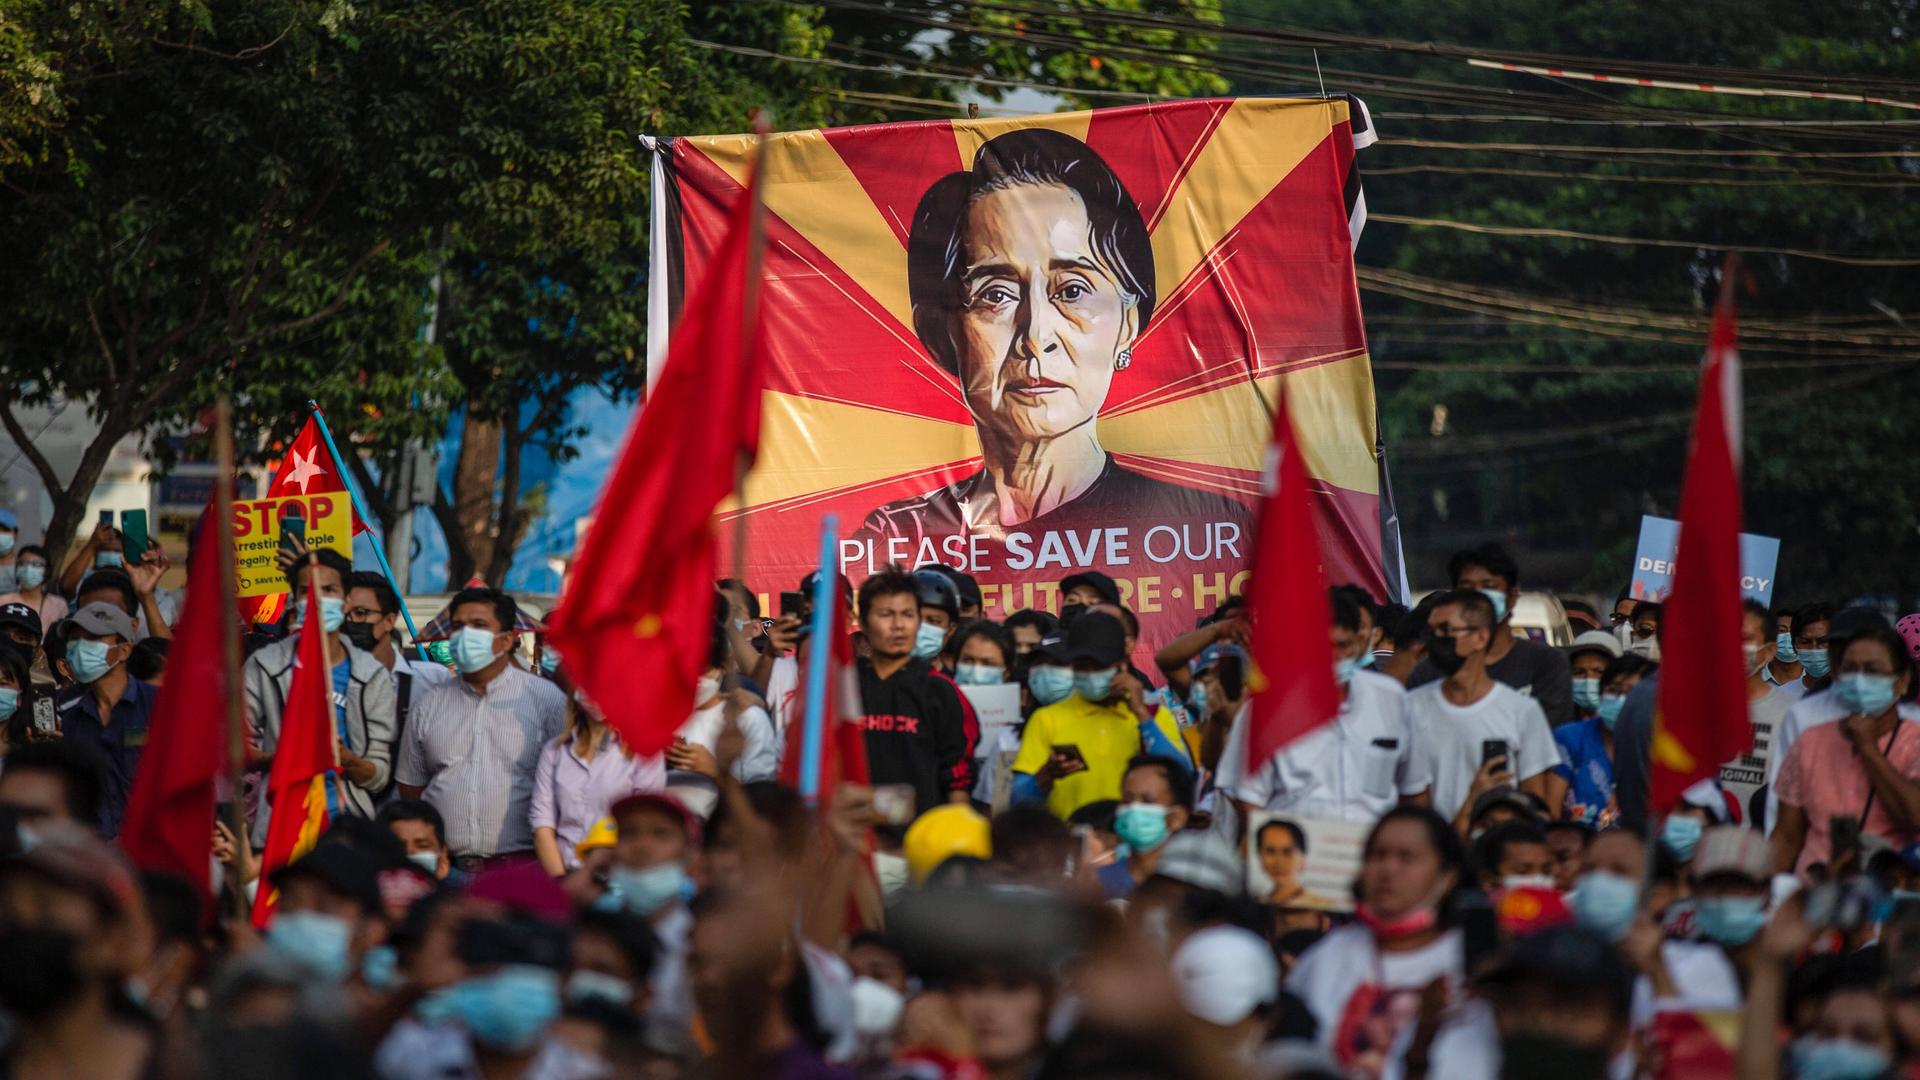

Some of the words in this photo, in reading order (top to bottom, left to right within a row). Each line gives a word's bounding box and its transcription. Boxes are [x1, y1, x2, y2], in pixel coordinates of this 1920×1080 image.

[231, 496, 334, 537] STOP
[232, 538, 280, 551] rrestin
[305, 534, 334, 547] ople
[839, 533, 992, 576] PLEASE
[1005, 527, 1130, 570] SAVE
[1143, 522, 1241, 563] OUR
[980, 575, 1162, 618] FUTRE
[1720, 768, 1763, 784] IGINAL
